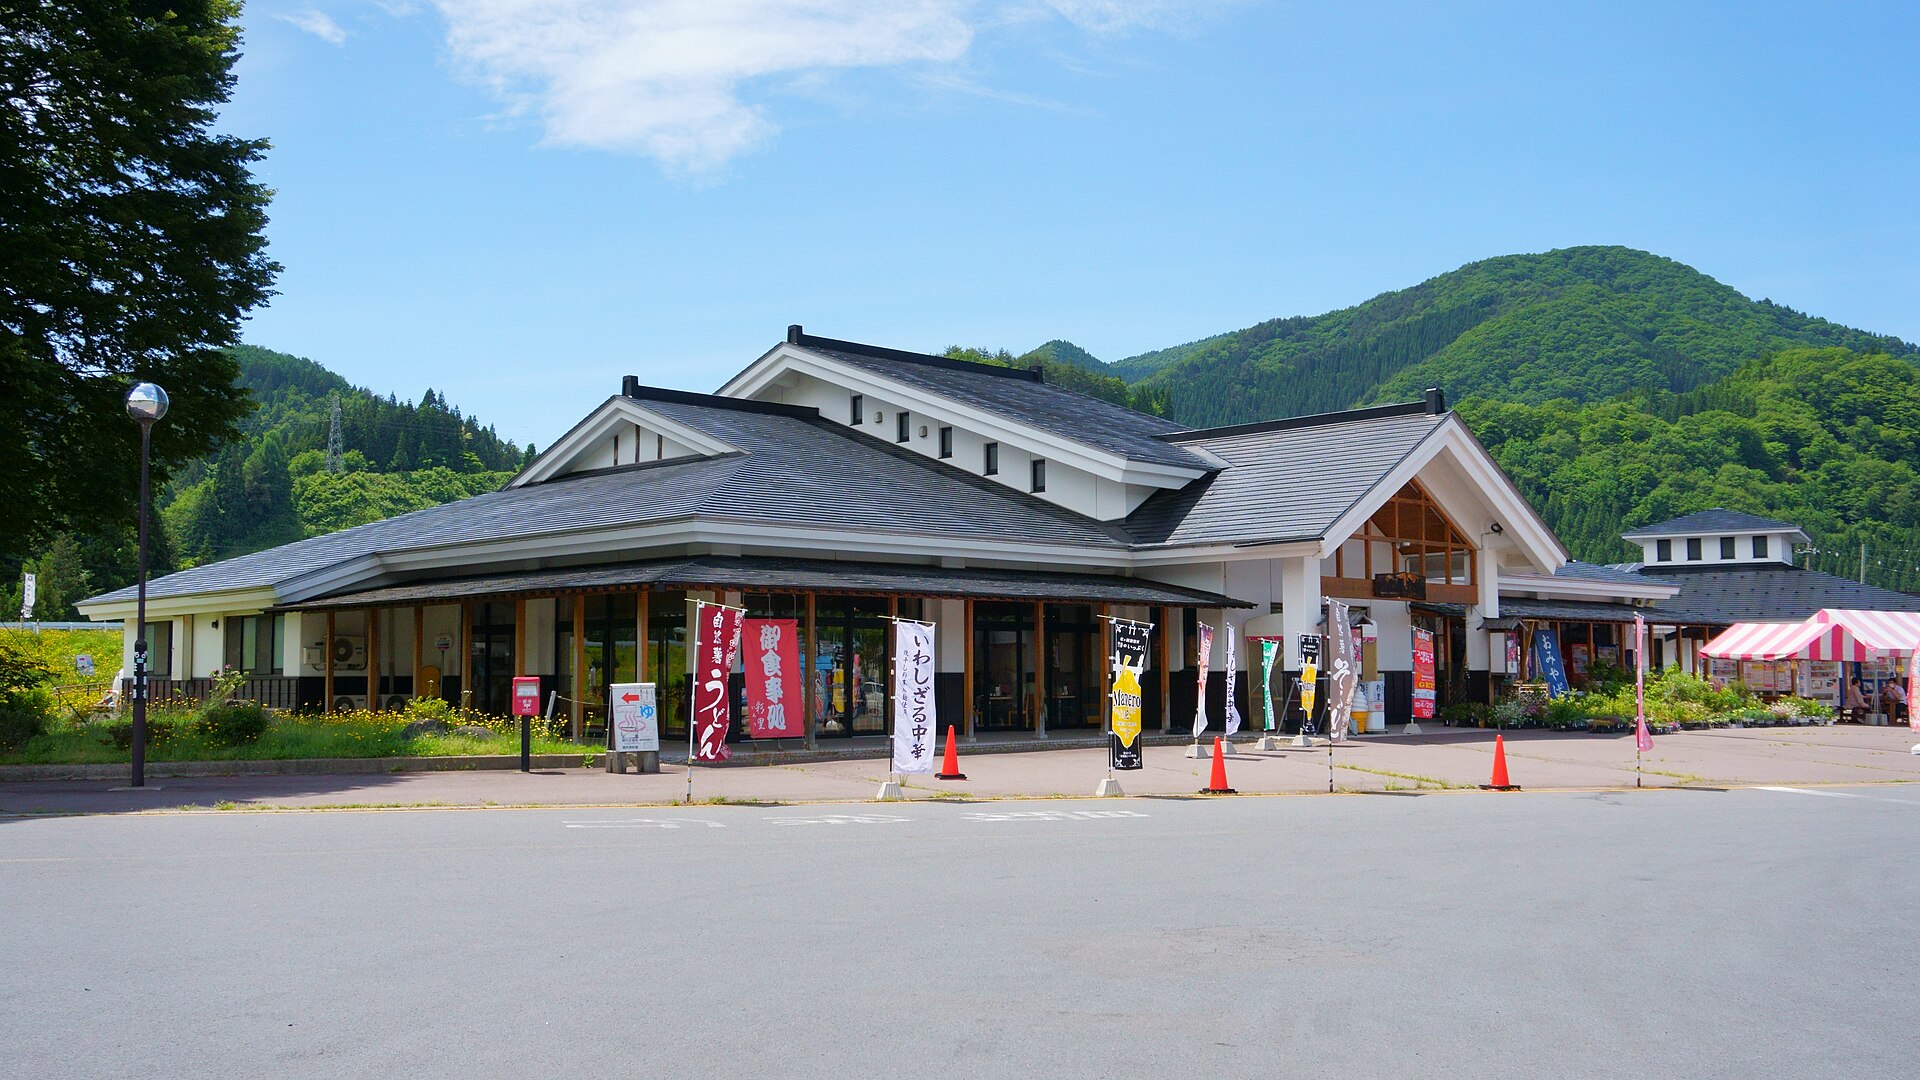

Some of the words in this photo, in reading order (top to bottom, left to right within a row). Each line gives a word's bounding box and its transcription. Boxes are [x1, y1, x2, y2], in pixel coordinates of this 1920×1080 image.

[640, 704, 654, 719] ゆ
[699, 668, 726, 759] うどん
[911, 635, 931, 760] いわしざる中華
